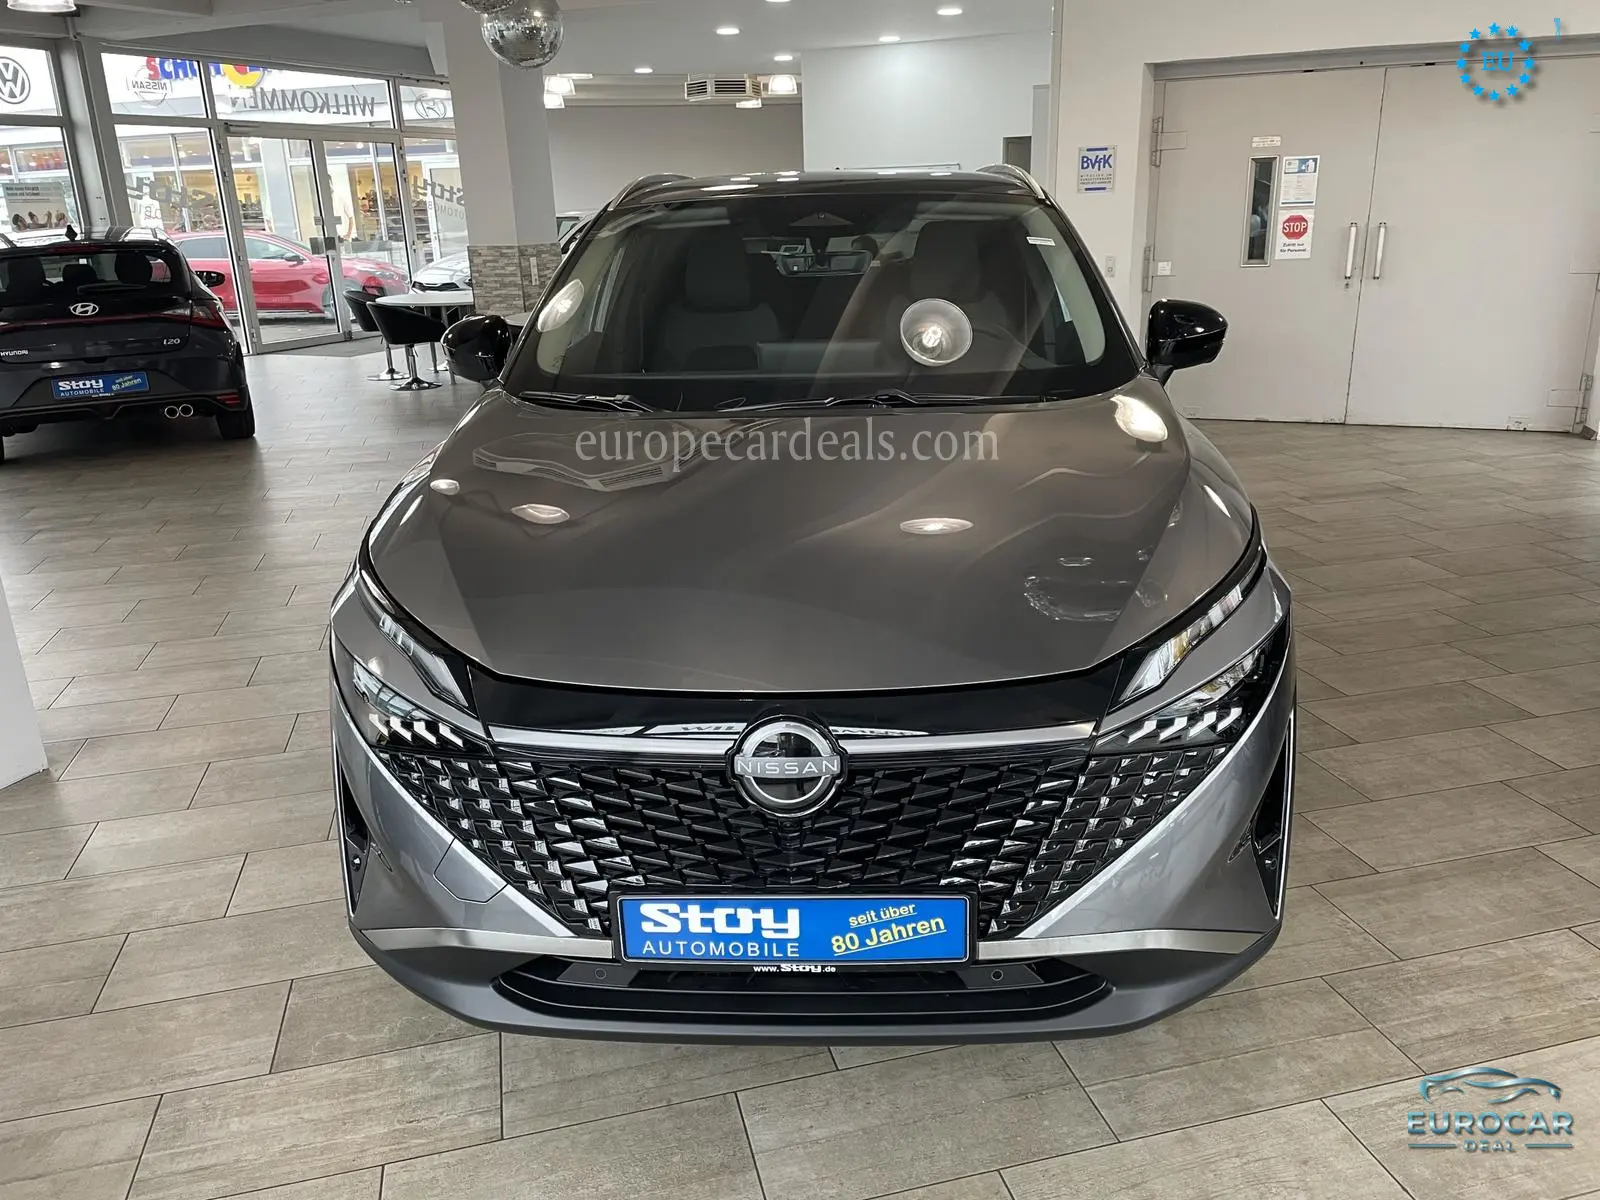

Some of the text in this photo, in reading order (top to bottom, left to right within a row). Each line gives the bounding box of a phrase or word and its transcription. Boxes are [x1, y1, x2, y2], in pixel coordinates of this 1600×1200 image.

[1081, 154, 1112, 171] BVfK
[1283, 222, 1308, 233] STOP
[58, 379, 104, 391] Stoy
[60, 388, 105, 397] AUTOMOBILE
[737, 759, 838, 774] NISSAN
[640, 903, 800, 939] Stoy
[848, 904, 916, 926] seit über
[831, 917, 945, 953] 80 Jahren
[643, 941, 800, 957] AUTOMOBILE
